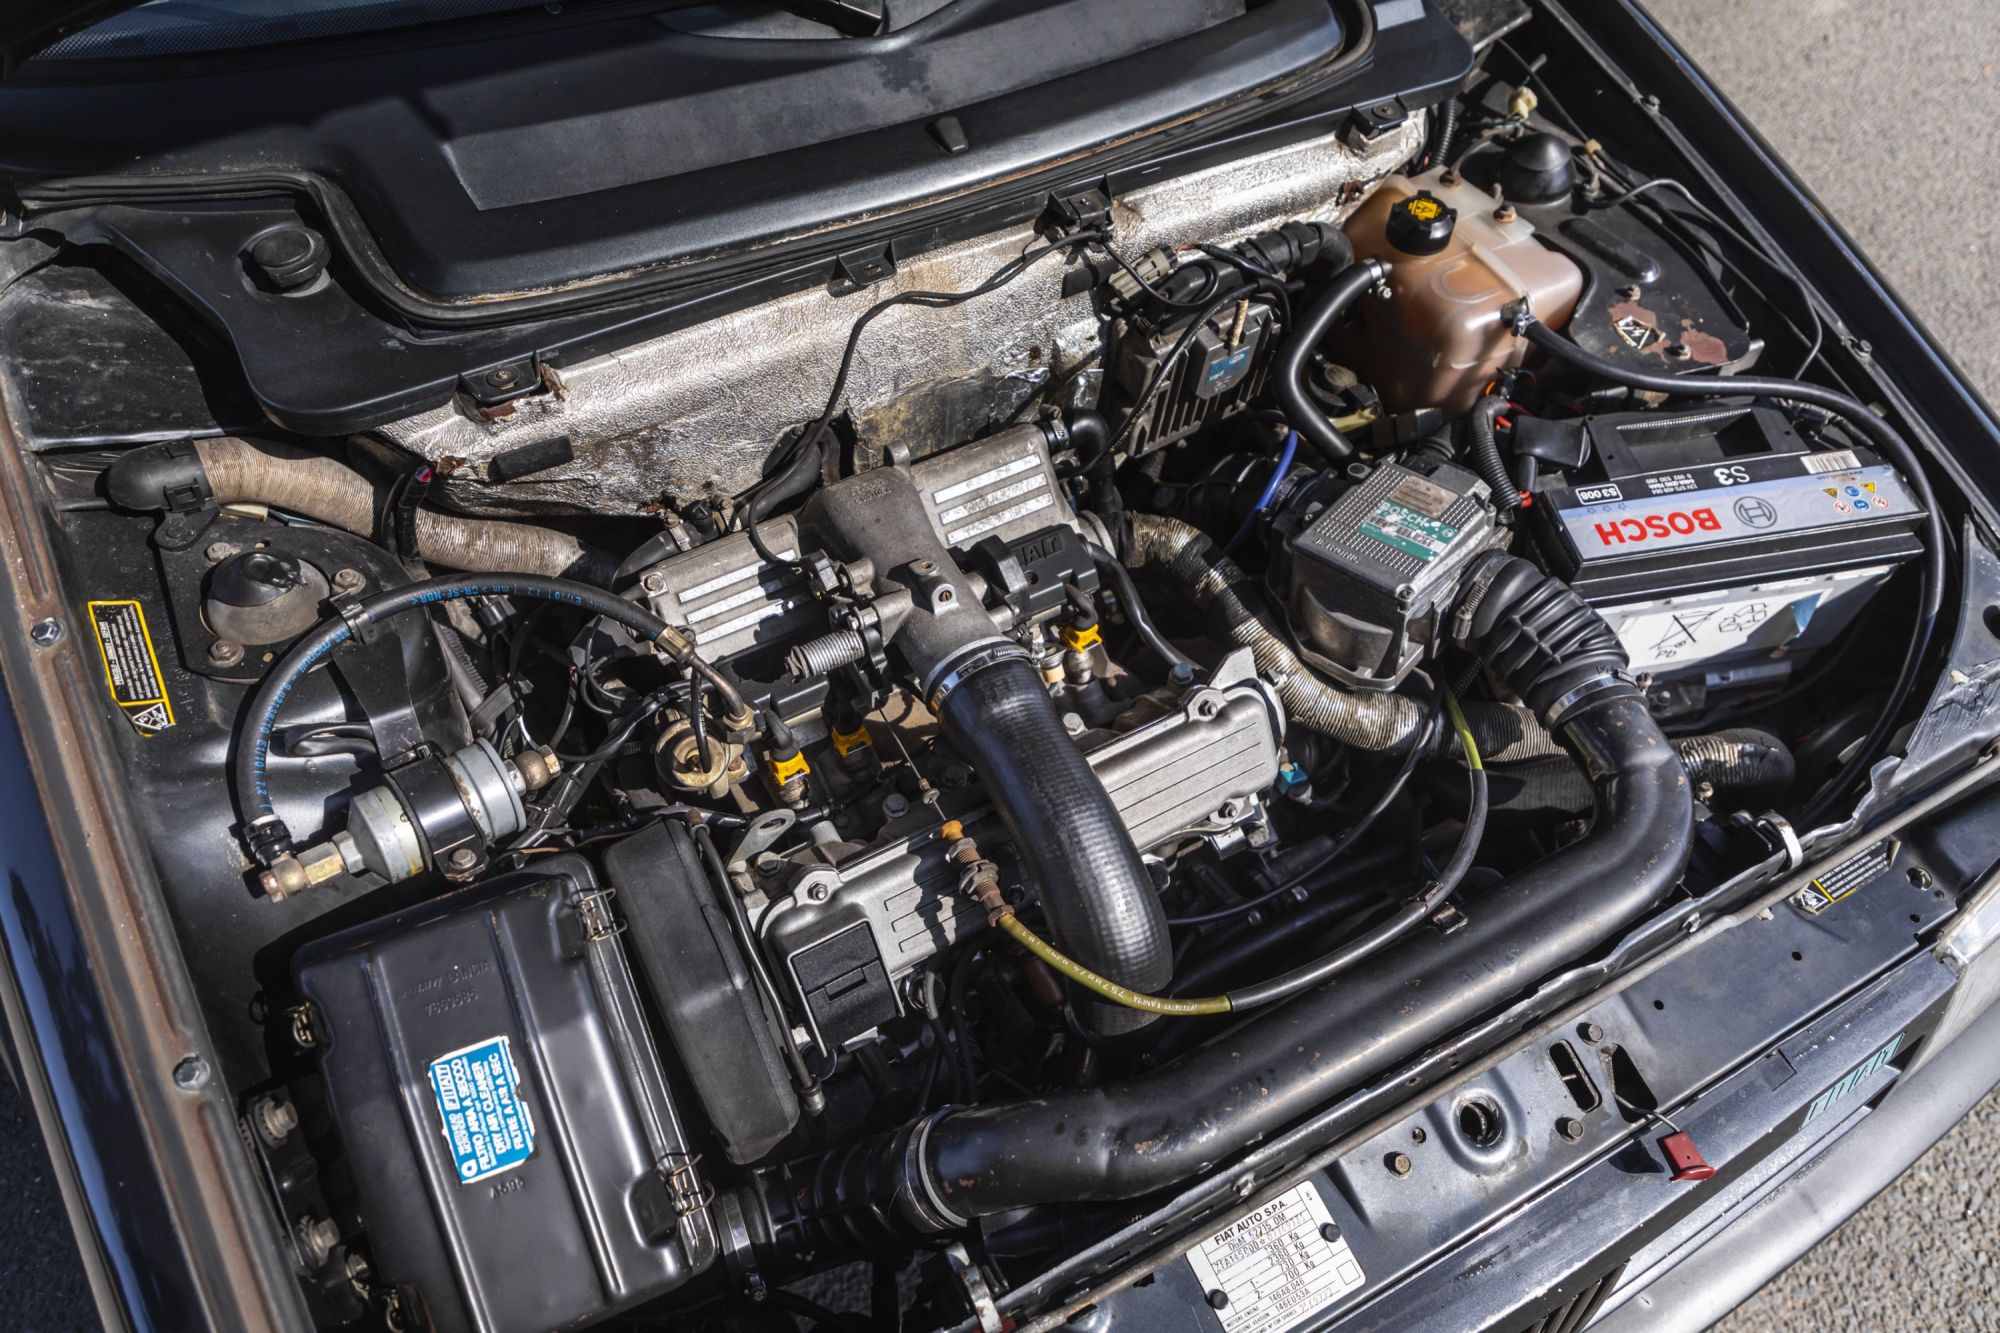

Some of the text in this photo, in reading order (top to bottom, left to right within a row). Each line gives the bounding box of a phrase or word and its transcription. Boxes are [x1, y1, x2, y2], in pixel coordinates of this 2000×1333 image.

[1711, 462, 1751, 488] S3
[1594, 508, 1722, 546] BOSCH
[1654, 649, 1678, 661] Pb
[488, 1053, 503, 1076] SEC
[435, 1065, 460, 1110] FIAT
[451, 1059, 469, 1098] SECCO
[471, 1061, 494, 1112] CLEANER
[496, 1076, 506, 1085] A
[462, 1097, 473, 1107] A
[498, 1086, 512, 1106] AIR
[465, 1107, 480, 1132] ARIA
[486, 1113, 501, 1132] AIR
[504, 1105, 515, 1115] A
[491, 1133, 507, 1155] DRY
[507, 1116, 525, 1150] FILTRE
[472, 1134, 491, 1171] FILTRO
[1214, 1200, 1288, 1245] FIAT AUTO S.P.A.
[1264, 1231, 1300, 1256] 1360 Kg
[1267, 1240, 1305, 1266] 2360 Kg
[1279, 1258, 1295, 1272] 730
[1299, 1250, 1311, 1261] Kg
[1284, 1267, 1300, 1282] 700
[1304, 1259, 1316, 1271] Kg
